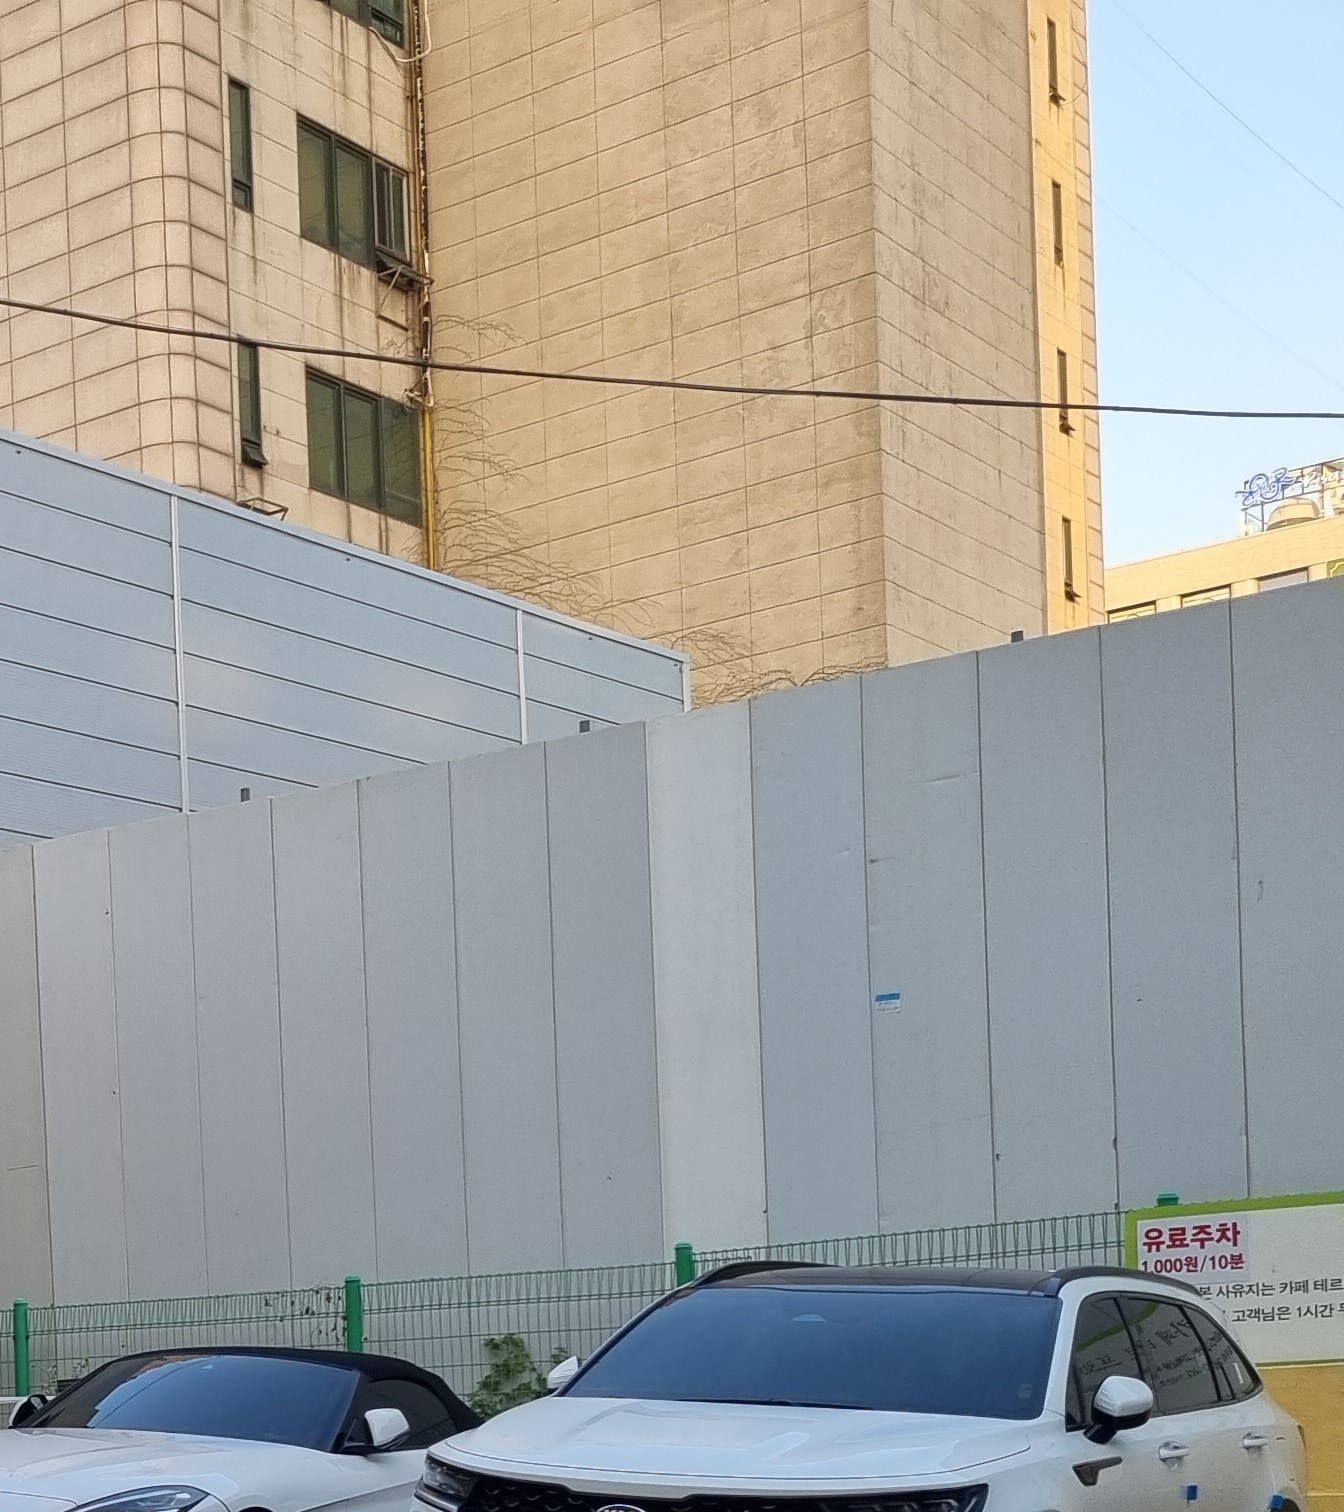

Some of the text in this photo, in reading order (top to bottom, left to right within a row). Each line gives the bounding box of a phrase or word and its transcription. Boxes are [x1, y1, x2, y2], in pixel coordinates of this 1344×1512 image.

[1142, 1221, 1241, 1254] 유료주차
[1215, 1281, 1276, 1299] 사유지는
[1279, 1280, 1310, 1295] 카페
[1313, 1278, 1344, 1293] 테르
[1231, 1306, 1292, 1323] 고객님은
[1296, 1303, 1335, 1319] 1시간
